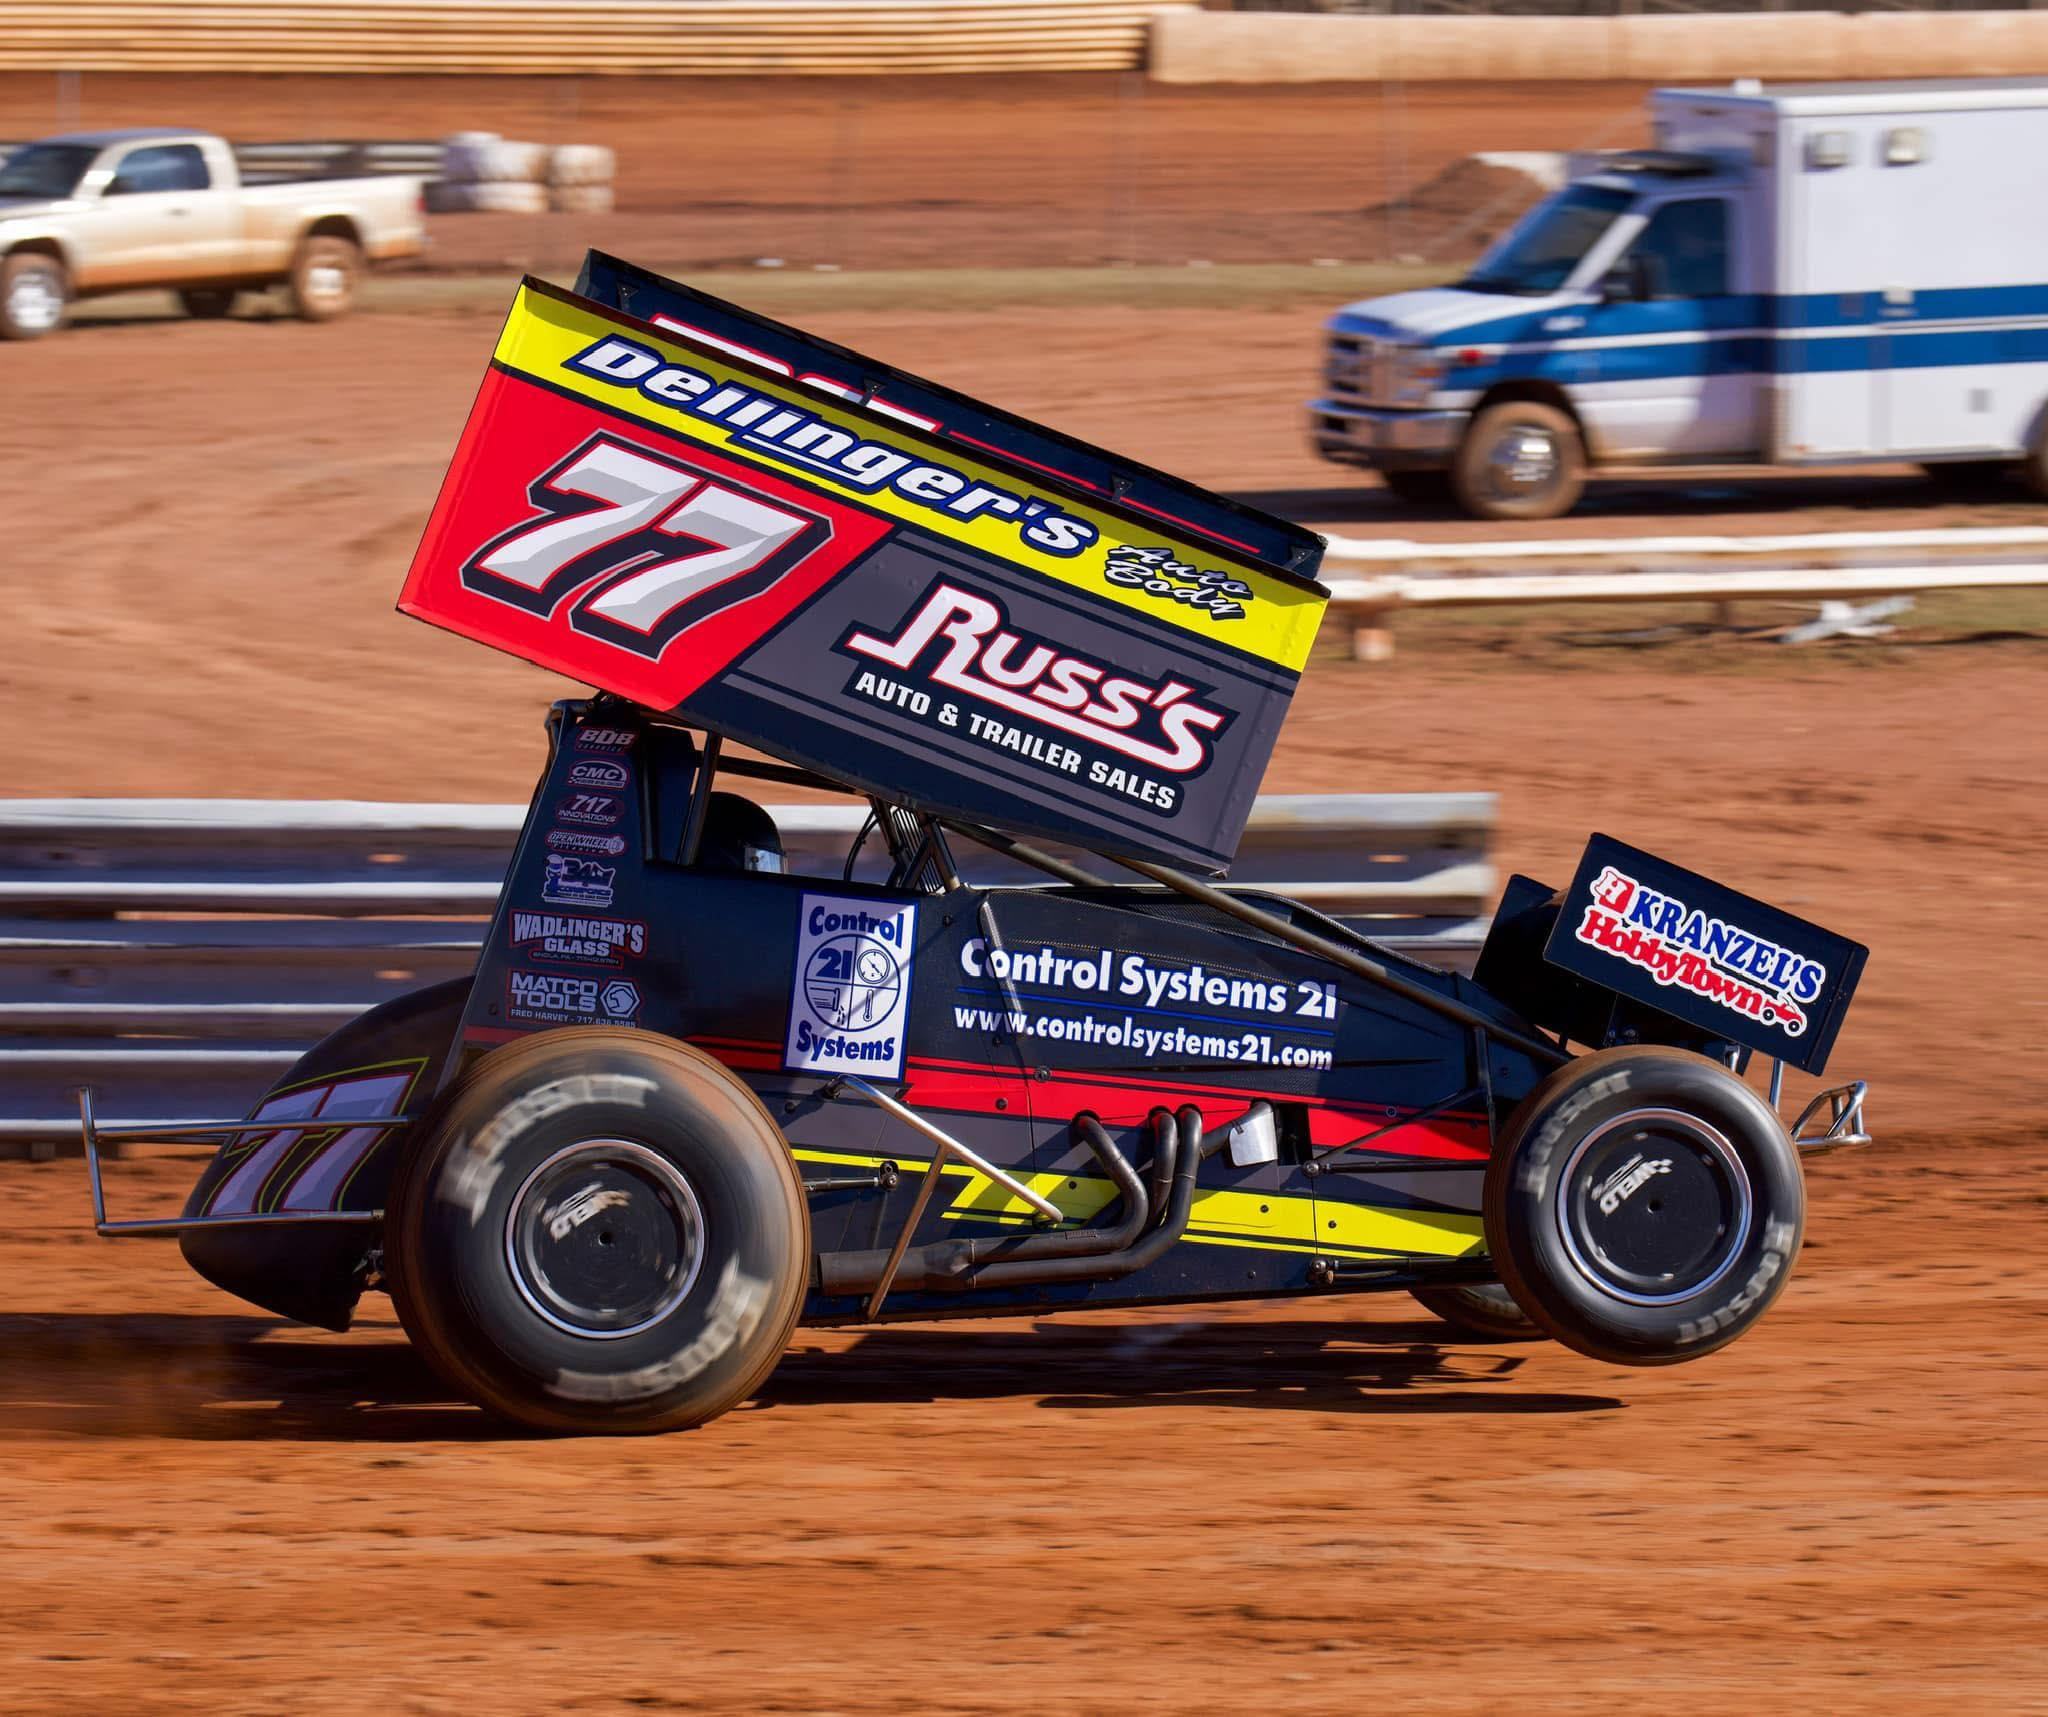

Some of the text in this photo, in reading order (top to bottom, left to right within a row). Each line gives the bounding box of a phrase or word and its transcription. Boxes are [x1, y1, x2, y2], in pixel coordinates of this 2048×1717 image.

[570, 336, 1095, 553] Dellinger's
[470, 436, 822, 647] 77
[1104, 559, 1244, 619] Body
[1107, 544, 1253, 597] Auto
[856, 673, 1176, 809] AUTO & TRAILER SALES
[572, 766, 620, 780] CMC
[571, 795, 613, 813] 717
[513, 912, 645, 954] WADLINGER'S
[544, 937, 610, 956] GLASS
[808, 906, 905, 948] Control
[1629, 890, 1823, 1000] KRANZEL'S
[511, 972, 598, 995] MATCO
[816, 949, 851, 978] 21
[960, 938, 1337, 1020] Control Systems 21
[511, 989, 597, 1013] TOOLS
[511, 1009, 533, 1018] FRED
[535, 1012, 569, 1023] HARVEY
[797, 1020, 895, 1062] Systems
[954, 1004, 1334, 1071] www.controlsystems21.com
